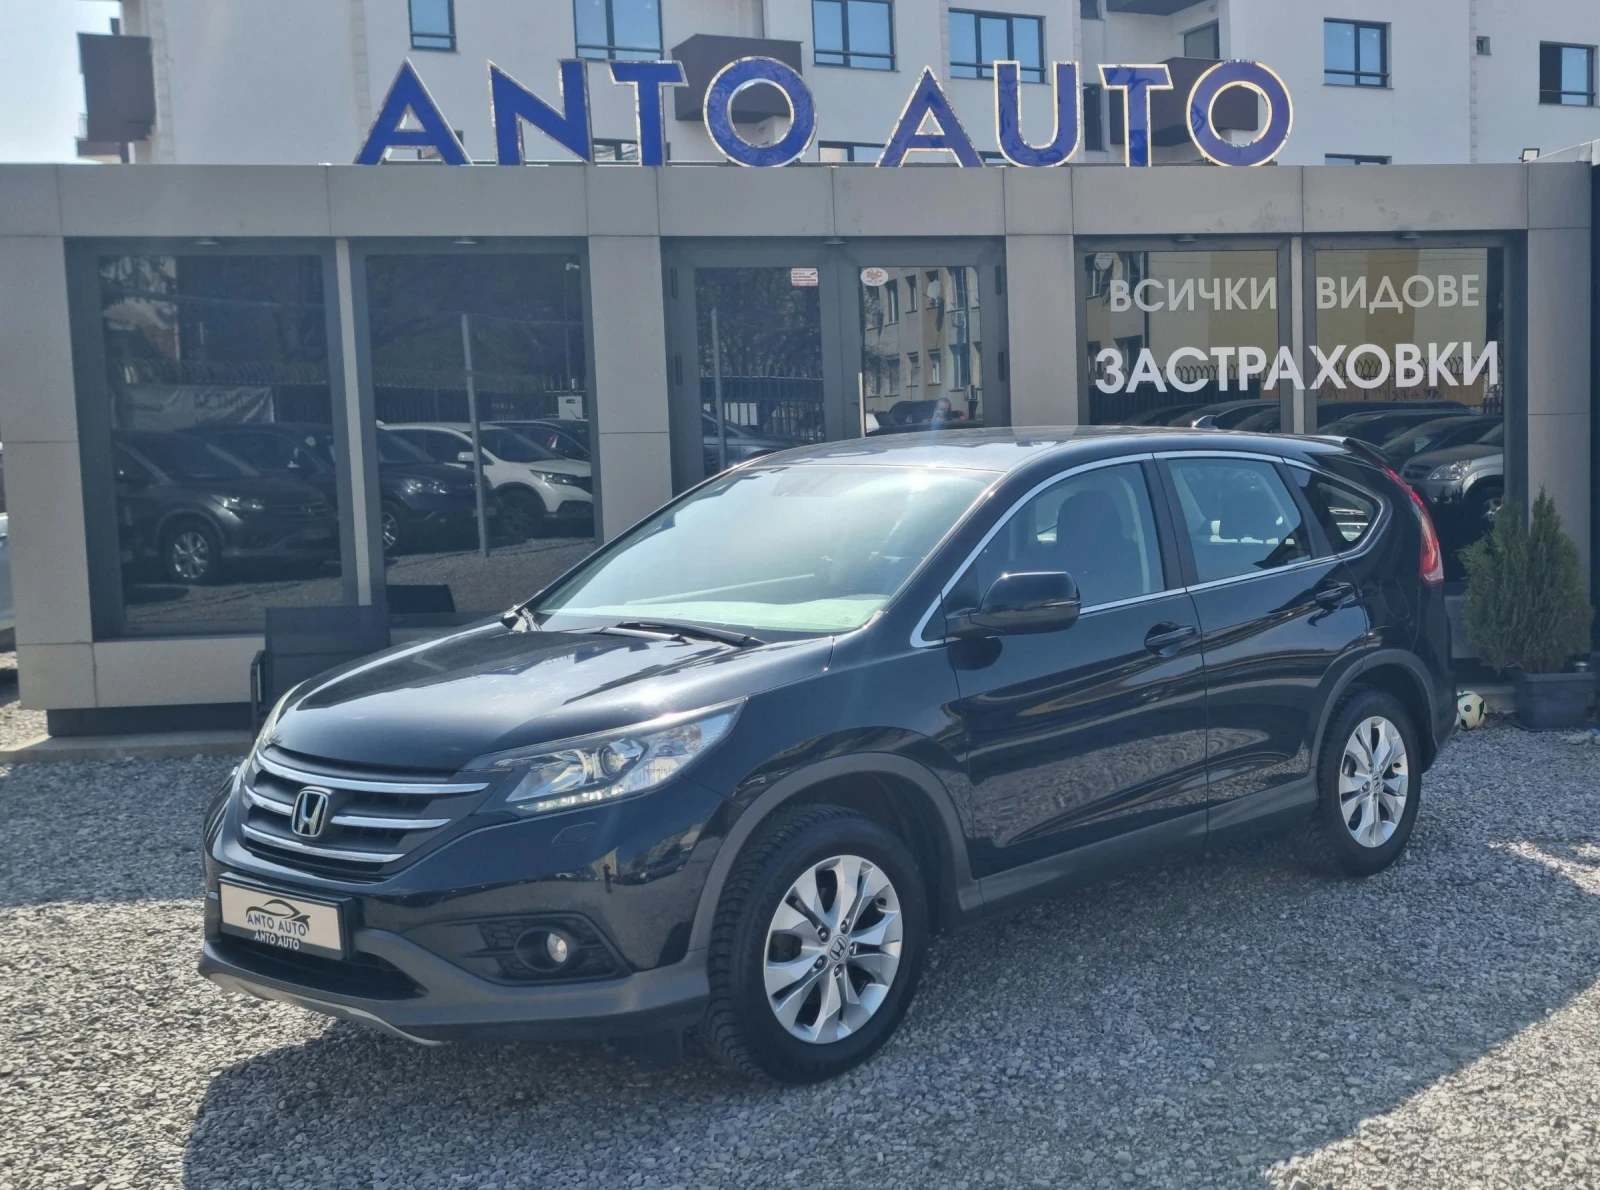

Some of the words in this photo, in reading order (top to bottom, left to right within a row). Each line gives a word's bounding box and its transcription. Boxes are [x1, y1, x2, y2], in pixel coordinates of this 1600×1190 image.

[353, 56, 817, 167] ANTO
[875, 58, 1293, 167] AUTO
[1110, 277, 1277, 312] ВСИЧКИ
[1316, 274, 1480, 314] ВИДОВЕ
[1095, 340, 1498, 394] ЗАСТРАХОВКИ
[247, 914, 275, 930] ANTO
[278, 920, 307, 936] AUTO
[254, 931, 276, 944] ANTO
[277, 936, 300, 950] AUTO
